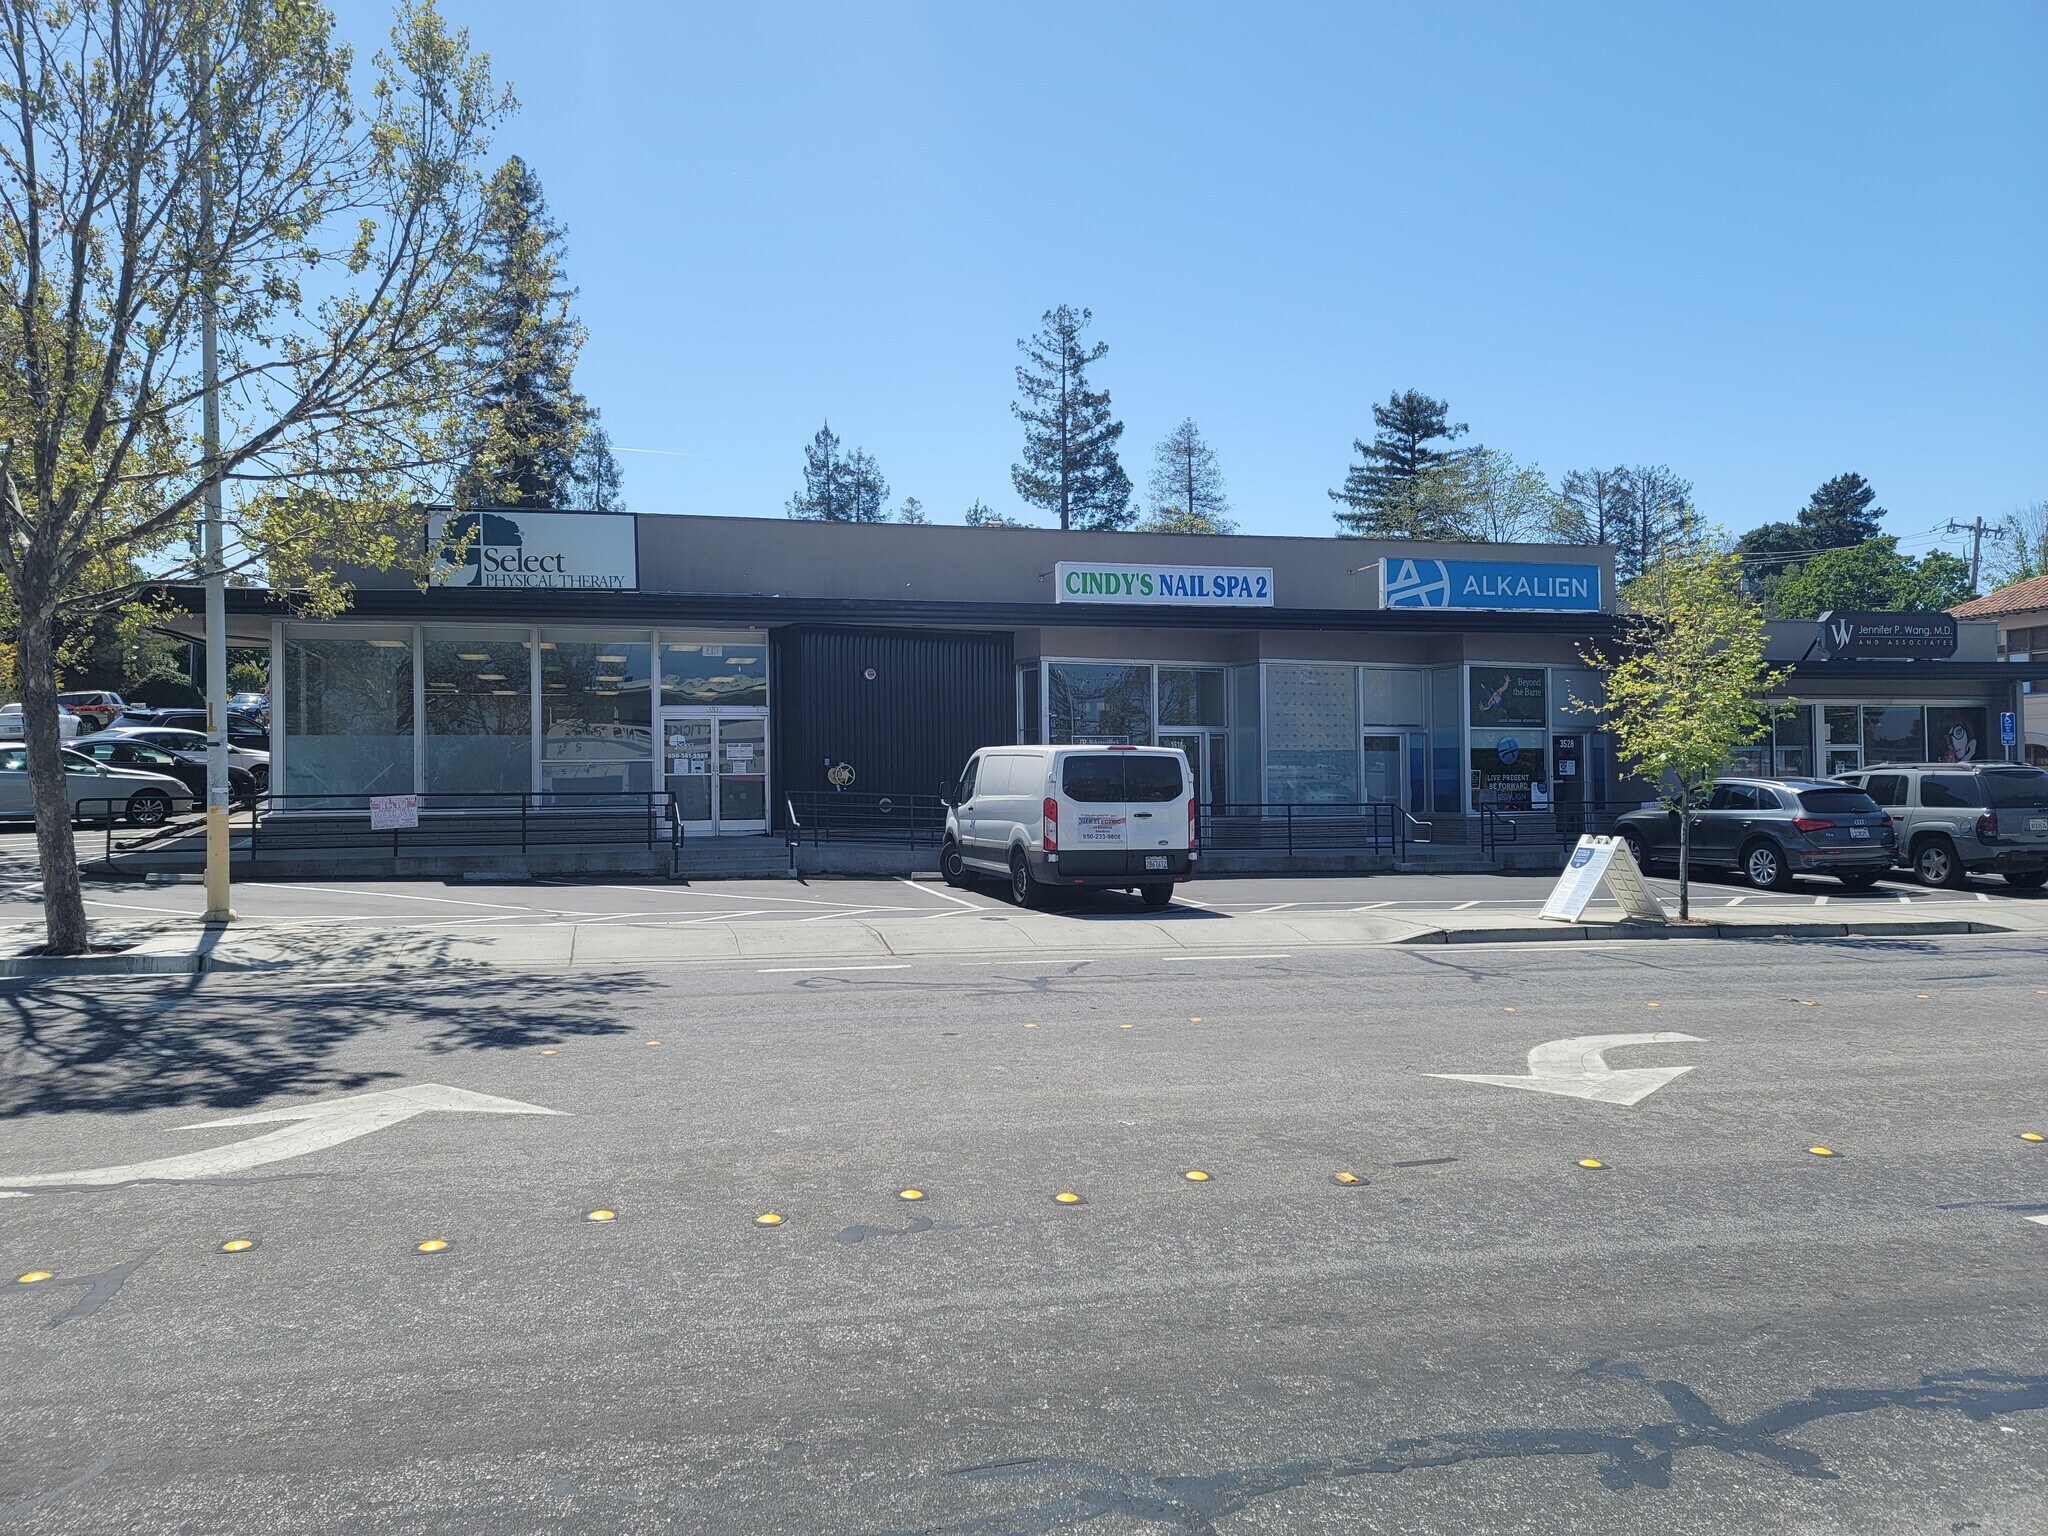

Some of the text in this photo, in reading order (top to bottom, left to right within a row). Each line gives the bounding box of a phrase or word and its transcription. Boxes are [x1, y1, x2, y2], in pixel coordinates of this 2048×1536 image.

[484, 547, 566, 573] Select
[486, 574, 625, 587] PHYSICAL THERAPY
[1065, 571, 1267, 598] CINDY'S NAIL SPA 2
[1462, 575, 1588, 598] ALKALIGN
[1858, 624, 1892, 635] Jennifer
[1894, 625, 1902, 635] P.
[1934, 626, 1953, 635] M.D.
[1517, 677, 1541, 687] Beyond
[1512, 687, 1542, 696] the Barre
[1559, 739, 1575, 748] 3528
